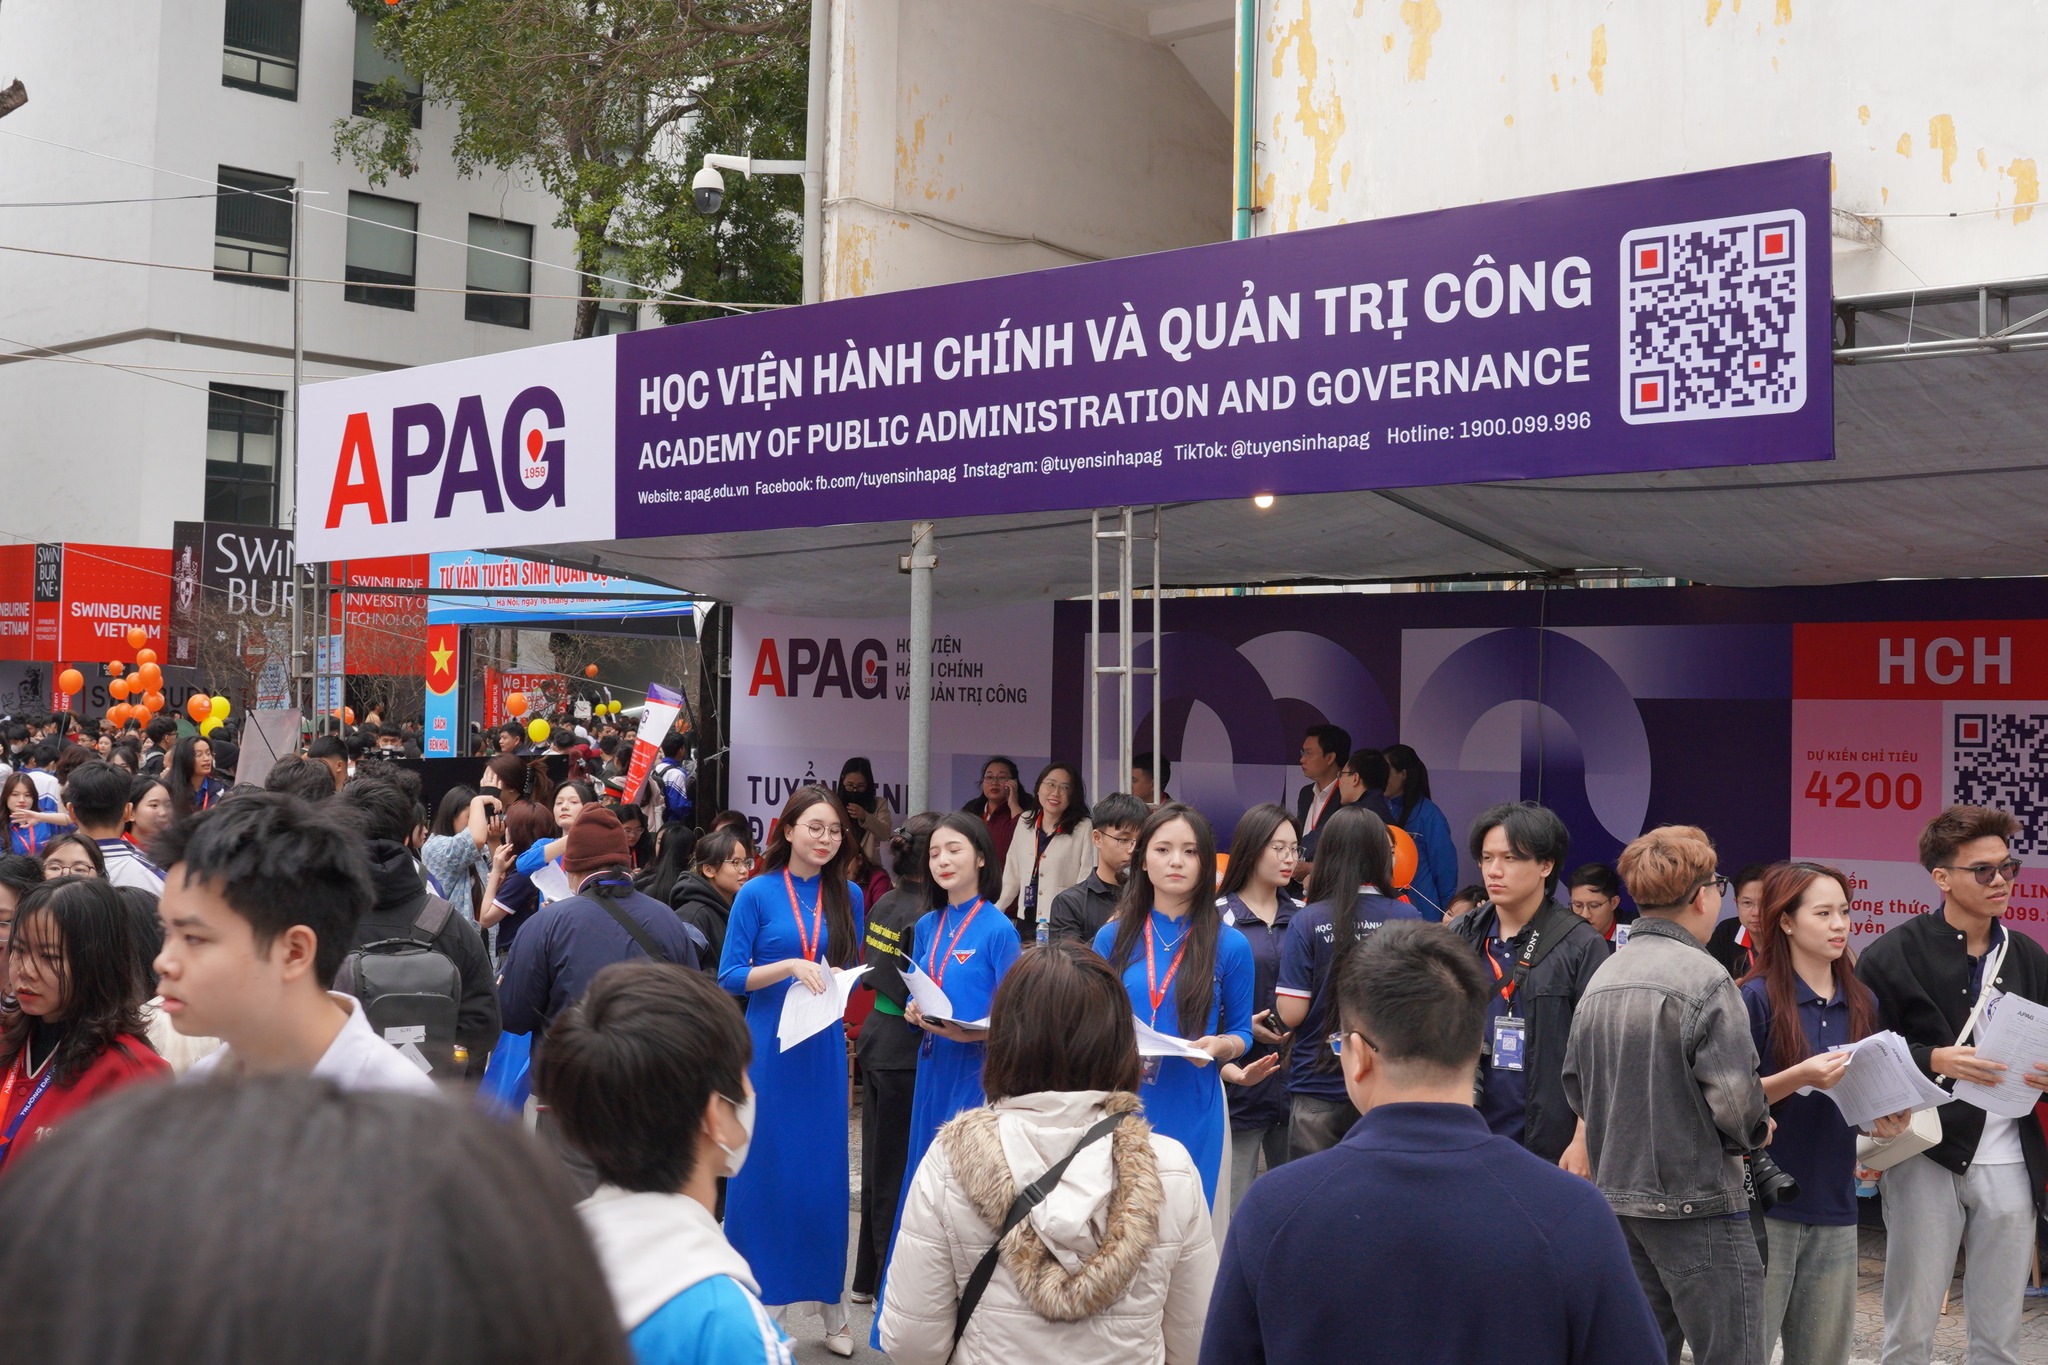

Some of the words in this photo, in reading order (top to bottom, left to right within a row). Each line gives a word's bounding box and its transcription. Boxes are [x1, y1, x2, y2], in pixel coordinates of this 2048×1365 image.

[641, 371, 709, 421] HỌC
[717, 351, 802, 410] VIỆN
[814, 339, 921, 395] HÀNH
[934, 318, 1073, 380] CHÍNH
[1085, 302, 1147, 362] VÀ
[1160, 280, 1300, 362] QUẢN
[1315, 279, 1408, 340] TRỊ
[1424, 254, 1591, 323] CÔNG
[639, 431, 761, 470] ACADEMY
[768, 426, 801, 457] OF
[809, 415, 909, 453] PUBLIC
[916, 384, 1208, 443] ADMINISTRATION
[1218, 376, 1296, 415] AND
[1307, 344, 1590, 406] GOVERNANCE
[325, 386, 566, 529] APAG
[638, 490, 682, 503] Website:
[685, 484, 748, 503] apag.edu.vn
[756, 477, 812, 494] Facebook:
[816, 467, 956, 489] fb.com/tuyensinhapag
[964, 461, 1037, 478] Instagram:
[1041, 449, 1162, 474] @tuyensinhapag
[1174, 442, 1227, 460] TikTok:
[1232, 432, 1370, 459] @tuyensinhapag
[1388, 425, 1453, 444] Hotline:
[1460, 412, 1590, 438] 1900.099.996
[523, 466, 547, 480] 1959
[351, 575, 424, 588] SWINBURNE
[522, 562, 550, 586] SINH
[0, 602, 30, 617] NBURNE
[71, 601, 162, 620] SWINBURNE
[416, 598, 427, 609] O
[748, 638, 888, 699] APAG
[937, 660, 983, 678] CHÍNH
[1879, 637, 2012, 685] HCH
[958, 686, 982, 706] TRỊ
[985, 683, 1027, 704] CÔNG
[1807, 750, 1826, 763] DỰ
[1828, 747, 1859, 762] KIẾN
[1860, 747, 1885, 763] CHỈ
[1888, 749, 1918, 763] TIÊU
[1805, 770, 1923, 811] 4200
[1889, 899, 1931, 915] thức
[1523, 930, 1541, 960] SONY
[2016, 1010, 2035, 1021] APAG
[1875, 1042, 1889, 1057] APAG
[1744, 1163, 1756, 1200] SONY
